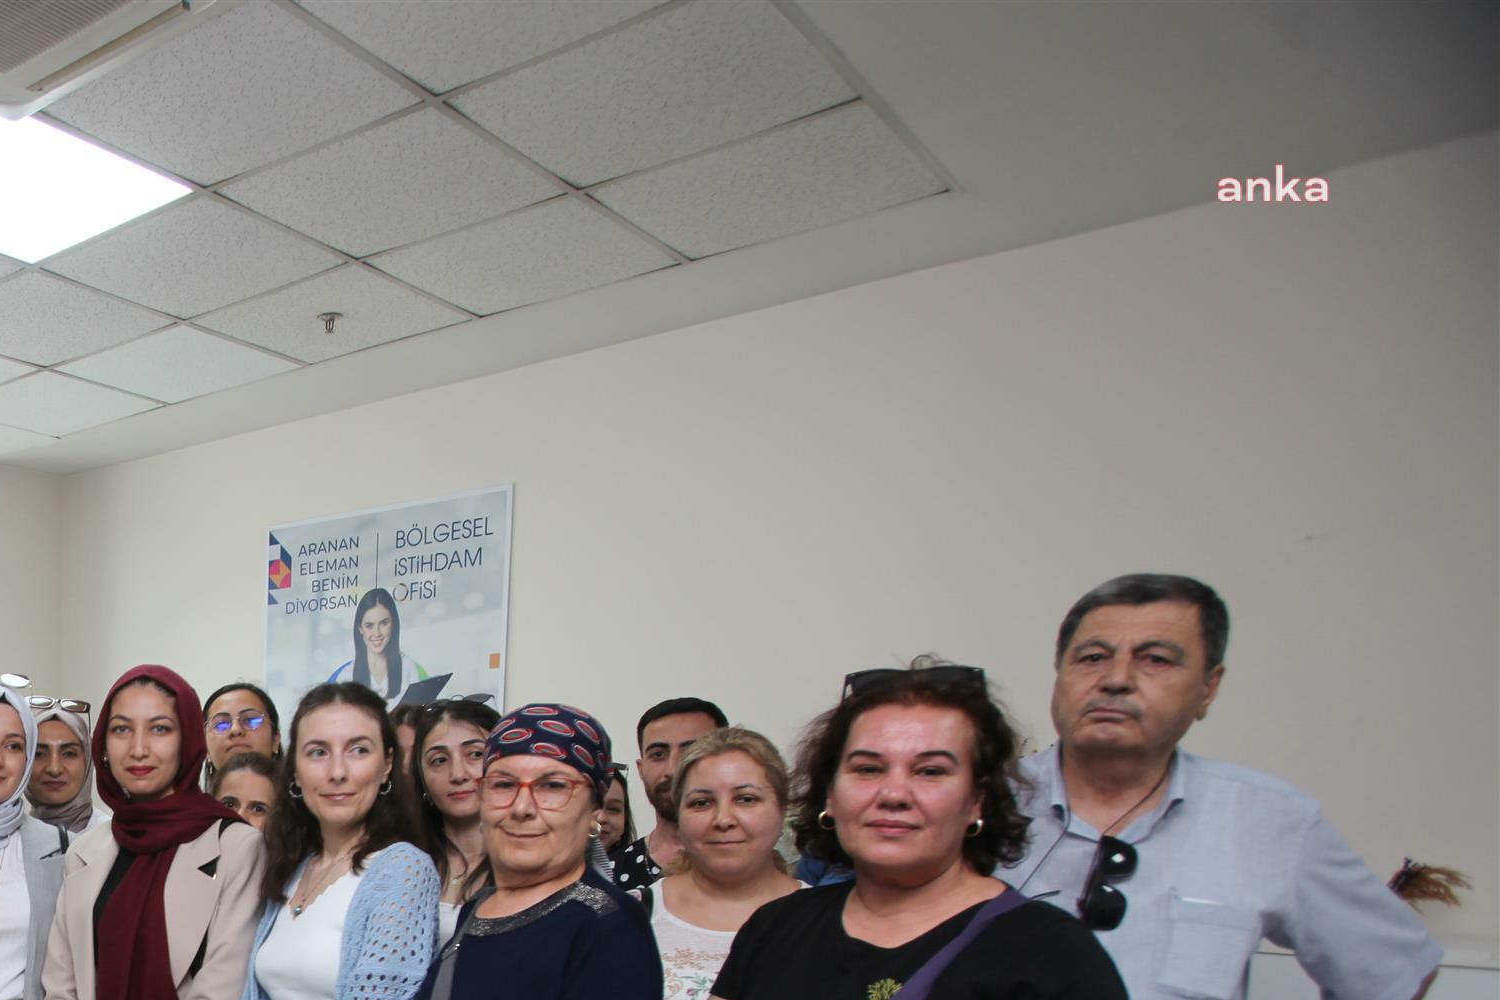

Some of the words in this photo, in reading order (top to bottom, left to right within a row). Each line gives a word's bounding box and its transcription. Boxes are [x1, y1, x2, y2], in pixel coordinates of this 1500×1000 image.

[395, 516, 494, 549] BÖLGESEL
[298, 535, 359, 558] ARANAN
[299, 554, 359, 576] ELEMAN
[394, 546, 482, 577] İSTİHDAM
[311, 573, 358, 593] BENİM
[392, 579, 437, 602] OFİSİ
[285, 593, 358, 615] DİYORSAN
